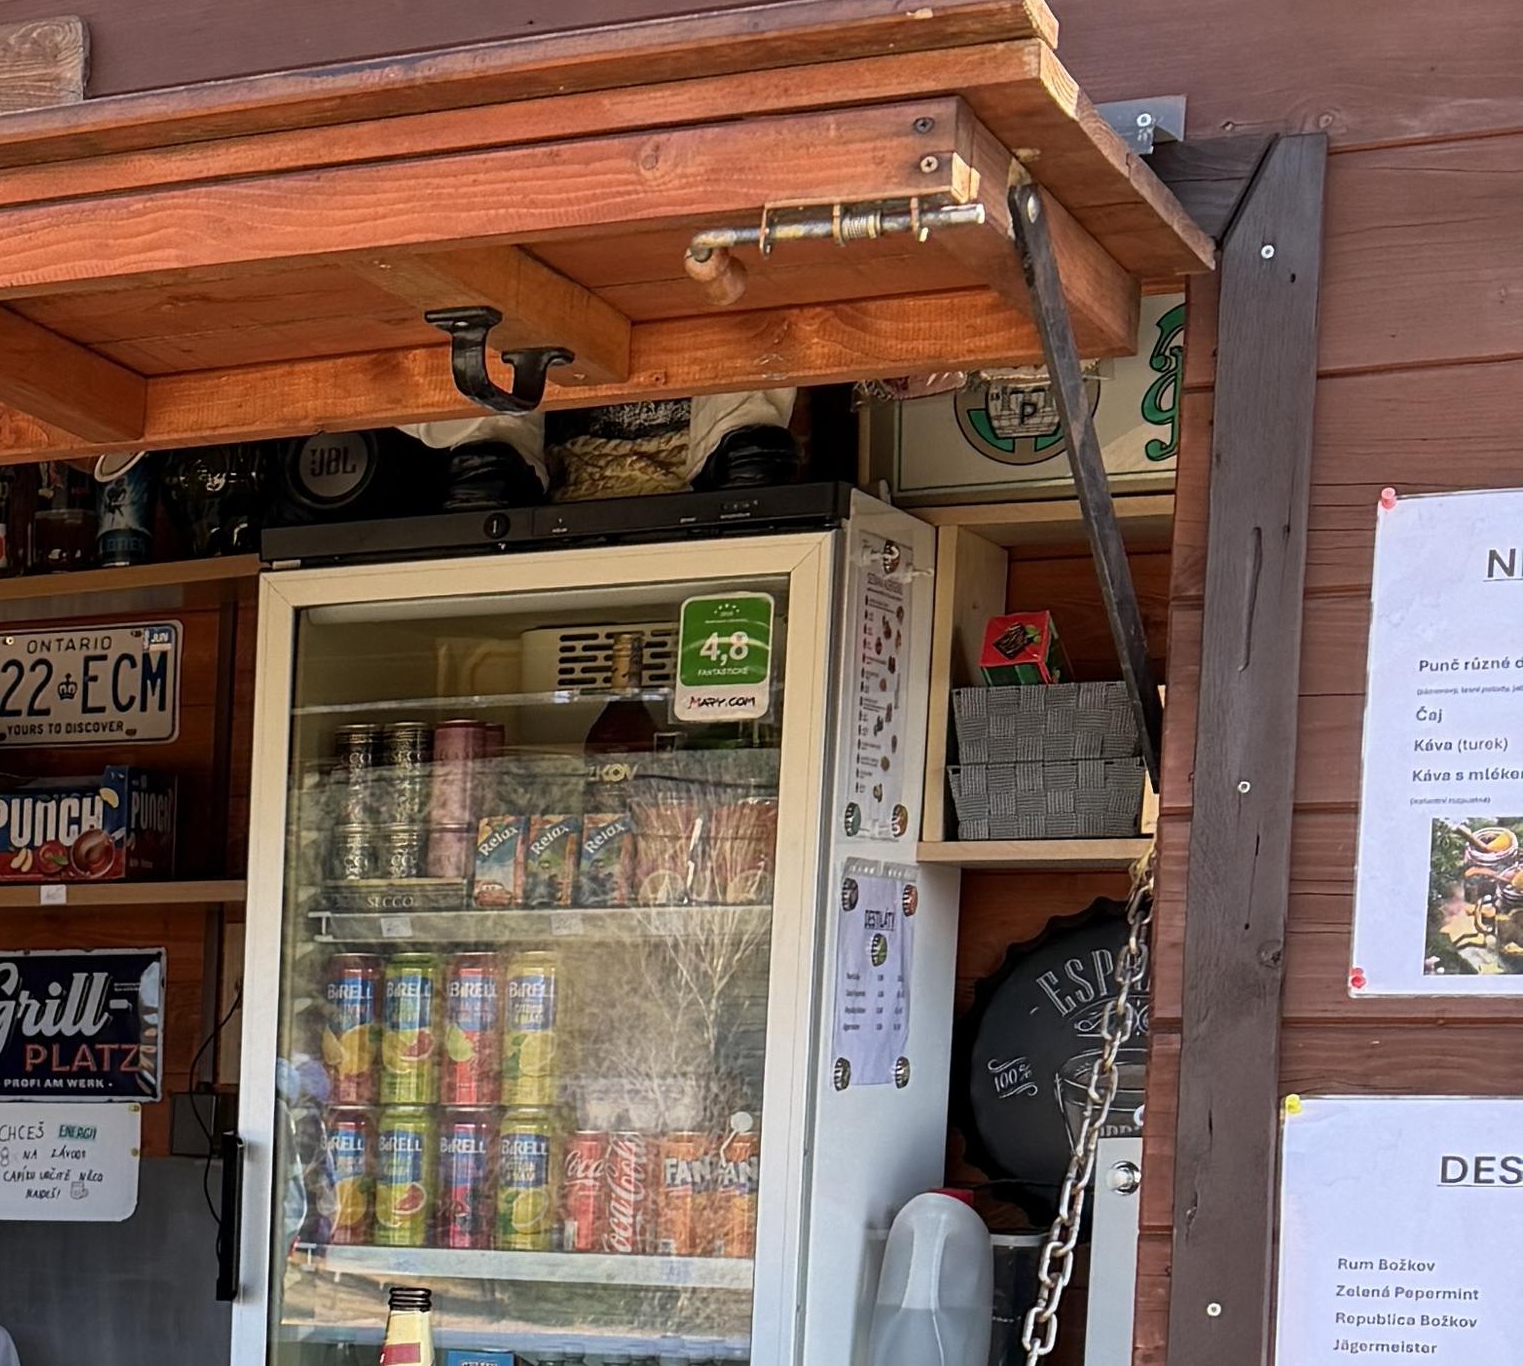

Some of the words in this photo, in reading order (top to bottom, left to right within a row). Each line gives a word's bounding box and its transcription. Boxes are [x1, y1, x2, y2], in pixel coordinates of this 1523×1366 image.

[309, 447, 357, 478] JBL
[27, 636, 112, 654] ONTARIO
[699, 631, 749, 666] 4,8
[1419, 658, 1460, 672] Punč
[81, 651, 168, 714] ECM
[1415, 706, 1443, 723] Čaj
[7, 723, 43, 736] YOURS
[48, 723, 62, 735] TO
[66, 720, 124, 734] DISCOVER
[1414, 738, 1453, 752] Káva
[1412, 769, 1451, 782] Káva
[1455, 771, 1464, 781] s
[130, 789, 173, 834] PUNCH
[478, 825, 518, 856] Relax
[530, 824, 569, 855] Relax
[584, 822, 626, 854] Relax
[367, 895, 414, 908] SECCO
[25, 1042, 141, 1073] PLATZ
[4, 1079, 41, 1088] PROFI
[44, 1079, 64, 1088] AM
[67, 1078, 105, 1088] WERK
[993, 1065, 1033, 1092] 100%
[22, 1149, 38, 1160] NA
[1338, 1257, 1374, 1270] Rum
[1378, 1257, 1436, 1272] Božkov
[1336, 1285, 1390, 1298] Zelená
[1394, 1286, 1479, 1301] Pepermint
[1335, 1312, 1416, 1327] Republica
[1420, 1314, 1478, 1328] Božkov
[1333, 1339, 1438, 1354] Jägermeister
